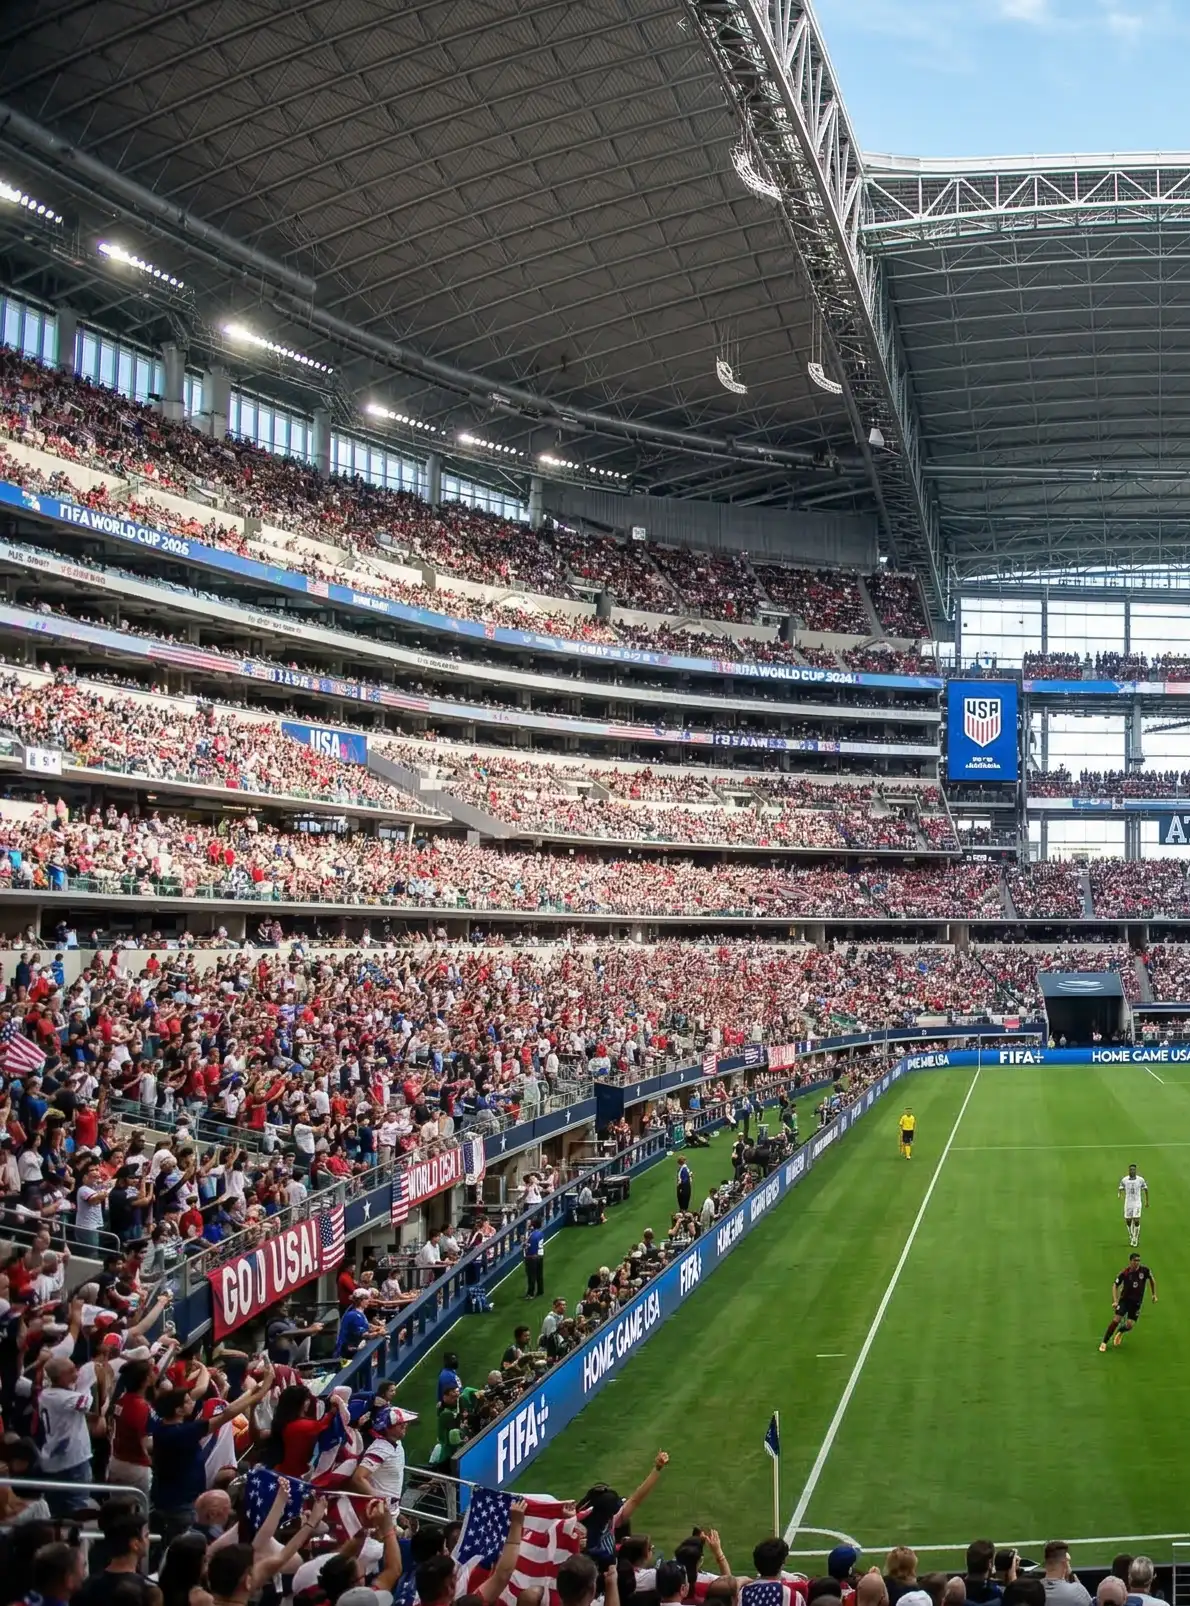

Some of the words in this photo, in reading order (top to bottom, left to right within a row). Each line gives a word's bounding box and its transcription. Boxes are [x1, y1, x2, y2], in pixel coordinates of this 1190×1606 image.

[91, 513, 136, 539] WORLD
[137, 527, 161, 547] CUP
[801, 671, 826, 682] CUP
[967, 701, 999, 719] USA
[310, 729, 341, 758] USA
[1092, 1049, 1130, 1063] HOME
[1132, 1049, 1170, 1062] GAME
[408, 1160, 438, 1201] WORLD
[270, 1219, 319, 1293] USA!
[583, 1330, 615, 1394] HOME
[616, 1305, 643, 1358] GAME
[643, 1288, 661, 1331] USA
